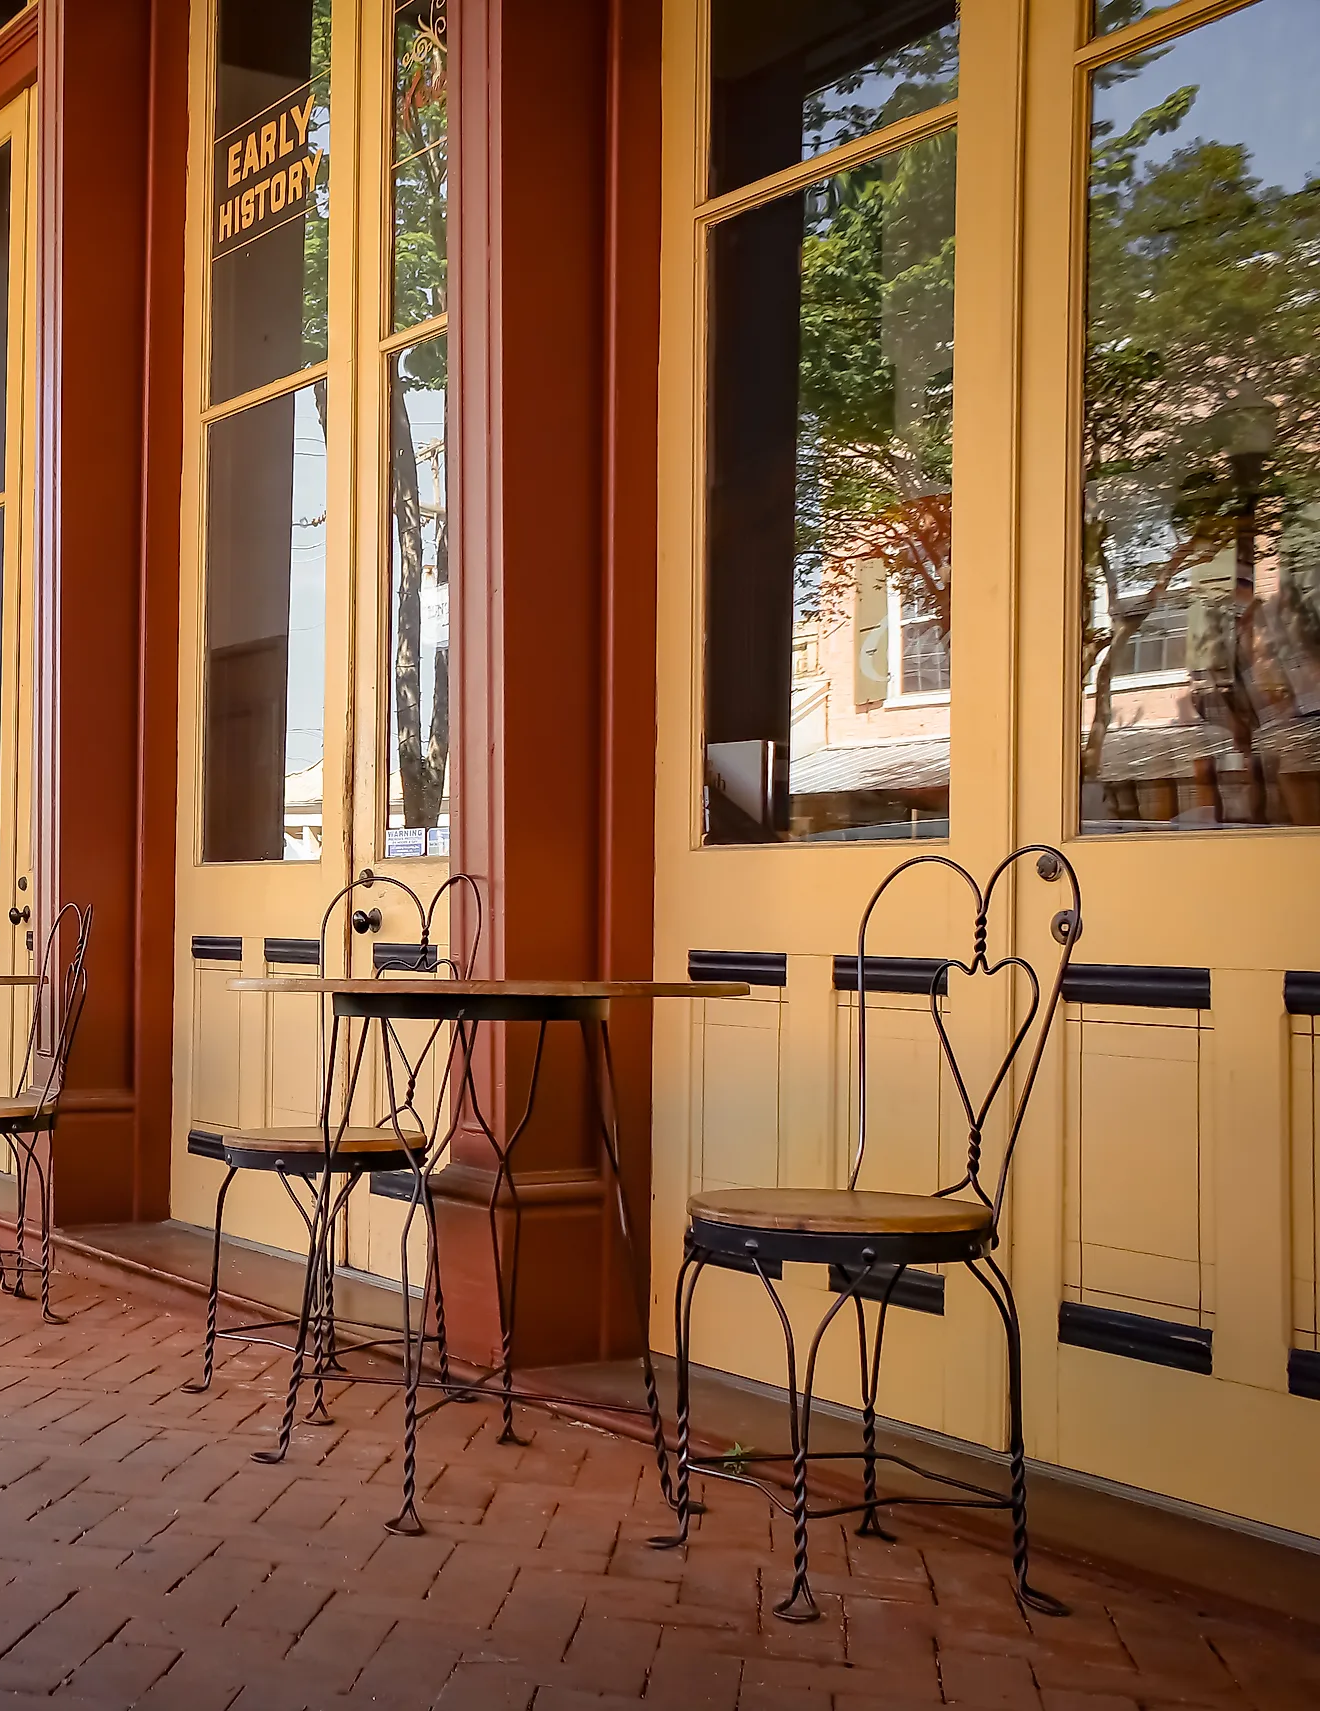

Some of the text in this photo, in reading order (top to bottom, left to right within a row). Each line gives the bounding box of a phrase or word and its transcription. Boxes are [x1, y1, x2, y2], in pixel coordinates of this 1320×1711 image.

[227, 93, 316, 189] EARLY
[218, 147, 325, 243] HISTORY
[387, 829, 423, 838] WARNING
